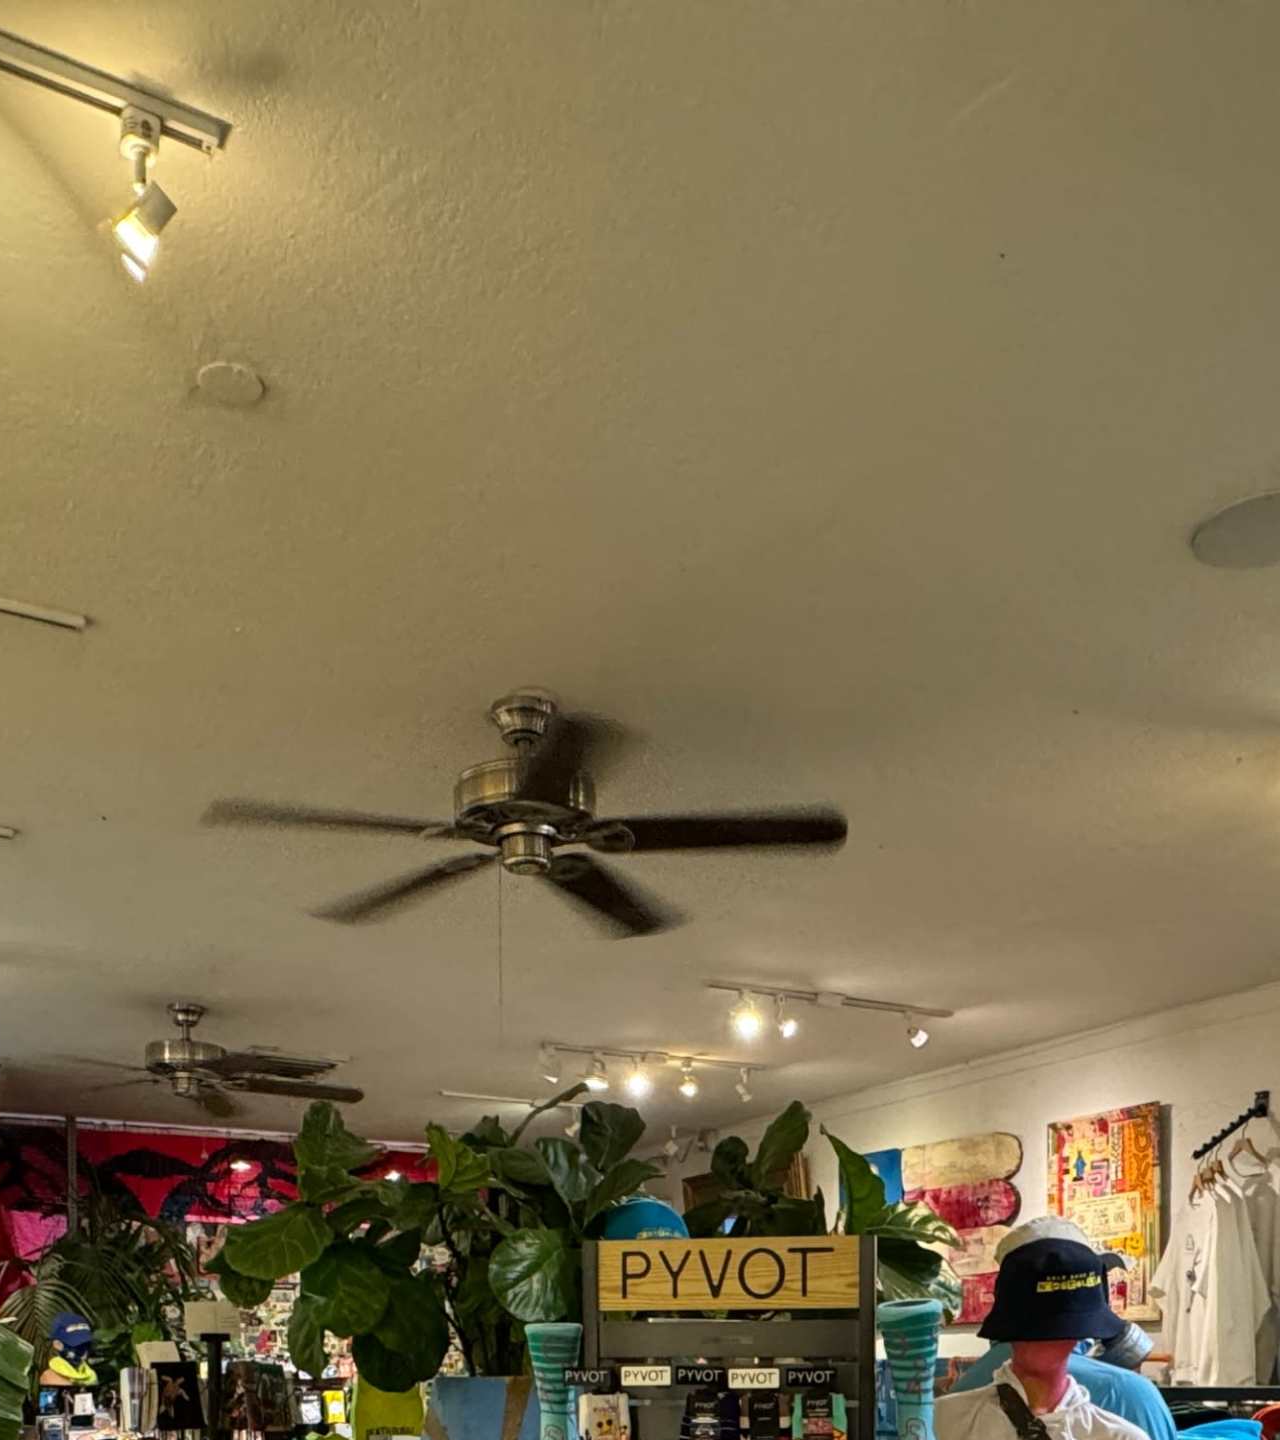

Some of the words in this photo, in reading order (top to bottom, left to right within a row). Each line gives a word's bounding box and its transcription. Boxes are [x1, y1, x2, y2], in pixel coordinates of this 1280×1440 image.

[622, 1246, 834, 1299] PYVOT
[565, 1369, 609, 1383] PYVOT
[624, 1369, 668, 1382] PYVOT
[677, 1369, 723, 1382] PYVOT
[731, 1371, 777, 1385] PYVOT
[788, 1370, 835, 1384] PYVOT
